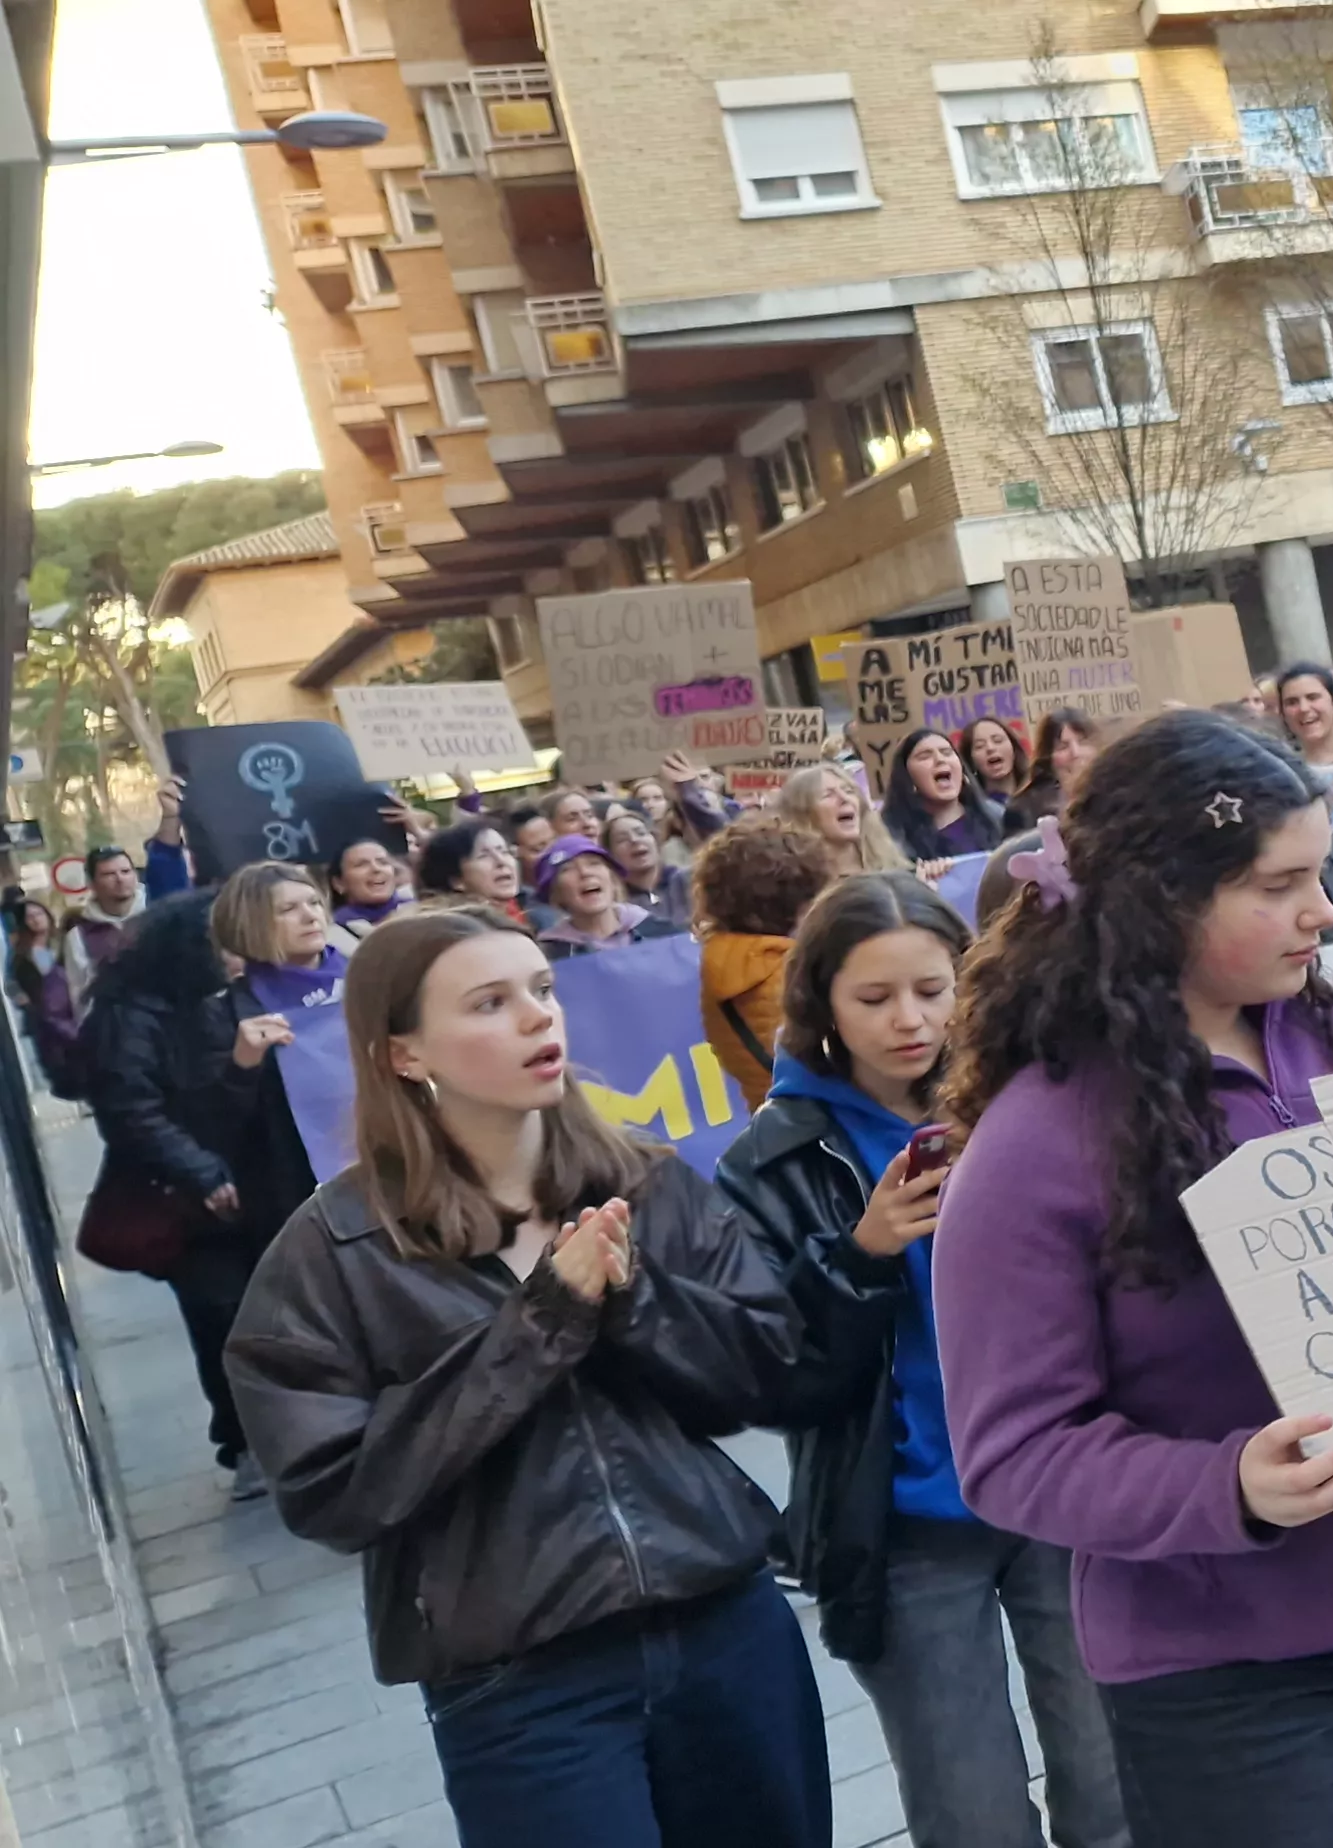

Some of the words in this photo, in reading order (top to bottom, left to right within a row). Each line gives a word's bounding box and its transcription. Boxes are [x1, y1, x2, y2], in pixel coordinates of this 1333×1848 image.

[1011, 566, 1031, 596] A
[1040, 562, 1103, 595] ESTA
[550, 601, 645, 649] ALGO
[1013, 602, 1102, 633] SOCIEDAD
[1102, 605, 1131, 635] LE
[860, 647, 893, 677] A
[906, 633, 943, 672] MÍ
[1017, 635, 1085, 664] INDIGNA
[858, 677, 907, 704] ME
[1022, 669, 1062, 697] UNA
[1067, 660, 1137, 690] MUJER
[858, 704, 909, 725] LAS
[923, 685, 1024, 733] MUJERE
[1108, 689, 1142, 717] UNA
[263, 820, 319, 860] 8M
